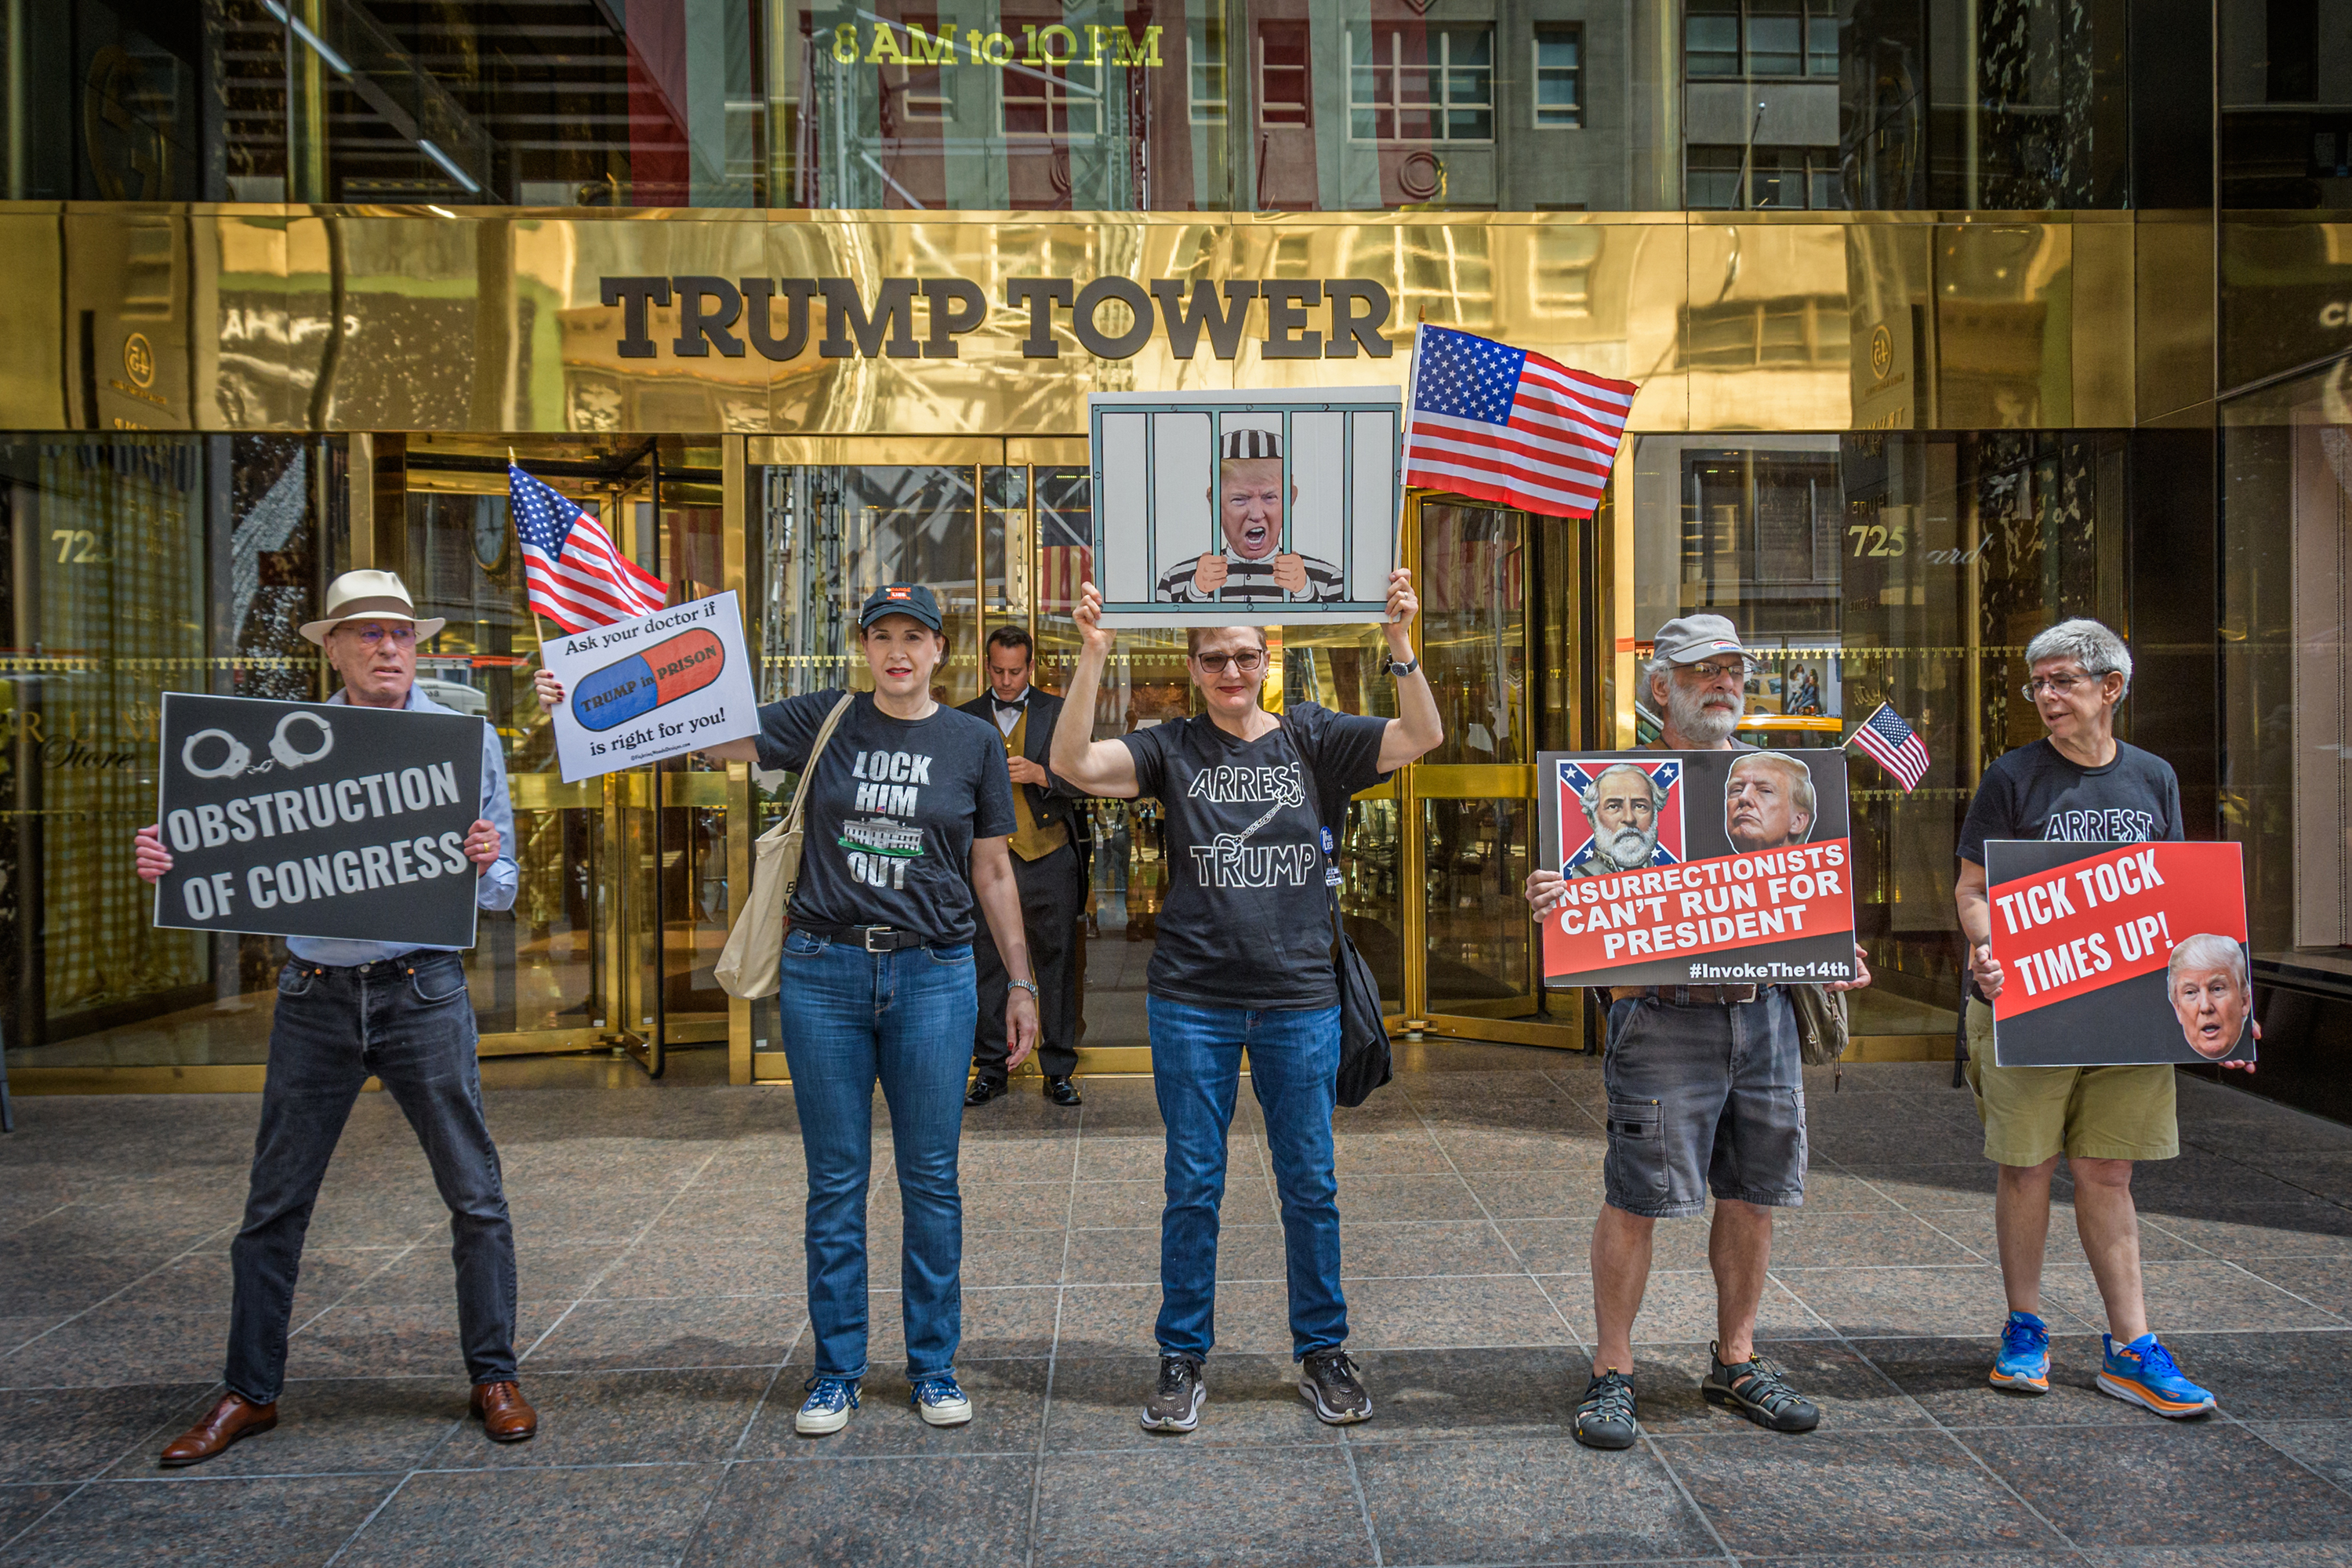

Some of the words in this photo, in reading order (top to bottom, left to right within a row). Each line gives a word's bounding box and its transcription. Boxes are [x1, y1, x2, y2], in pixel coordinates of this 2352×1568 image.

[833, 23, 859, 64] 8
[865, 22, 959, 65] AM
[966, 29, 1014, 67] to
[1022, 24, 1078, 66] 10
[1084, 25, 1164, 67] PM
[600, 276, 987, 361] TRUMP
[1007, 275, 1394, 361] TOWER
[1848, 525, 1907, 557] 725
[565, 636, 598, 655] Ask
[602, 626, 640, 648] your
[644, 608, 699, 634] doctor
[704, 601, 717, 618] if
[580, 681, 637, 713] TRUMP
[641, 677, 655, 688] in
[656, 644, 718, 681] PRISON
[590, 741, 606, 756] is
[611, 728, 655, 750] right
[659, 720, 685, 739] for
[689, 707, 726, 732] you!
[852, 750, 932, 786] LOCK
[1187, 762, 1305, 803] ARREST
[167, 760, 461, 853] OBSTRUCTION
[855, 782, 919, 818] HIM
[2045, 808, 2153, 841] ARREST
[183, 872, 236, 921] OF
[246, 831, 469, 909] CONGRESS
[847, 851, 911, 890] OUT
[1189, 844, 1316, 887] TRUMP
[1552, 844, 1845, 909] NSURRECTIONISTS
[1560, 896, 1668, 935] CAN'T
[1679, 882, 1759, 918] RUN
[1767, 869, 1843, 905] FOR
[1995, 877, 2076, 935] TICK
[2075, 848, 2165, 908] TOCK
[1603, 904, 1806, 960] PRESIDENT
[2013, 932, 2113, 996] TIMES
[2114, 911, 2174, 962] UP!
[1690, 961, 1850, 978] #InvokeThe14th
